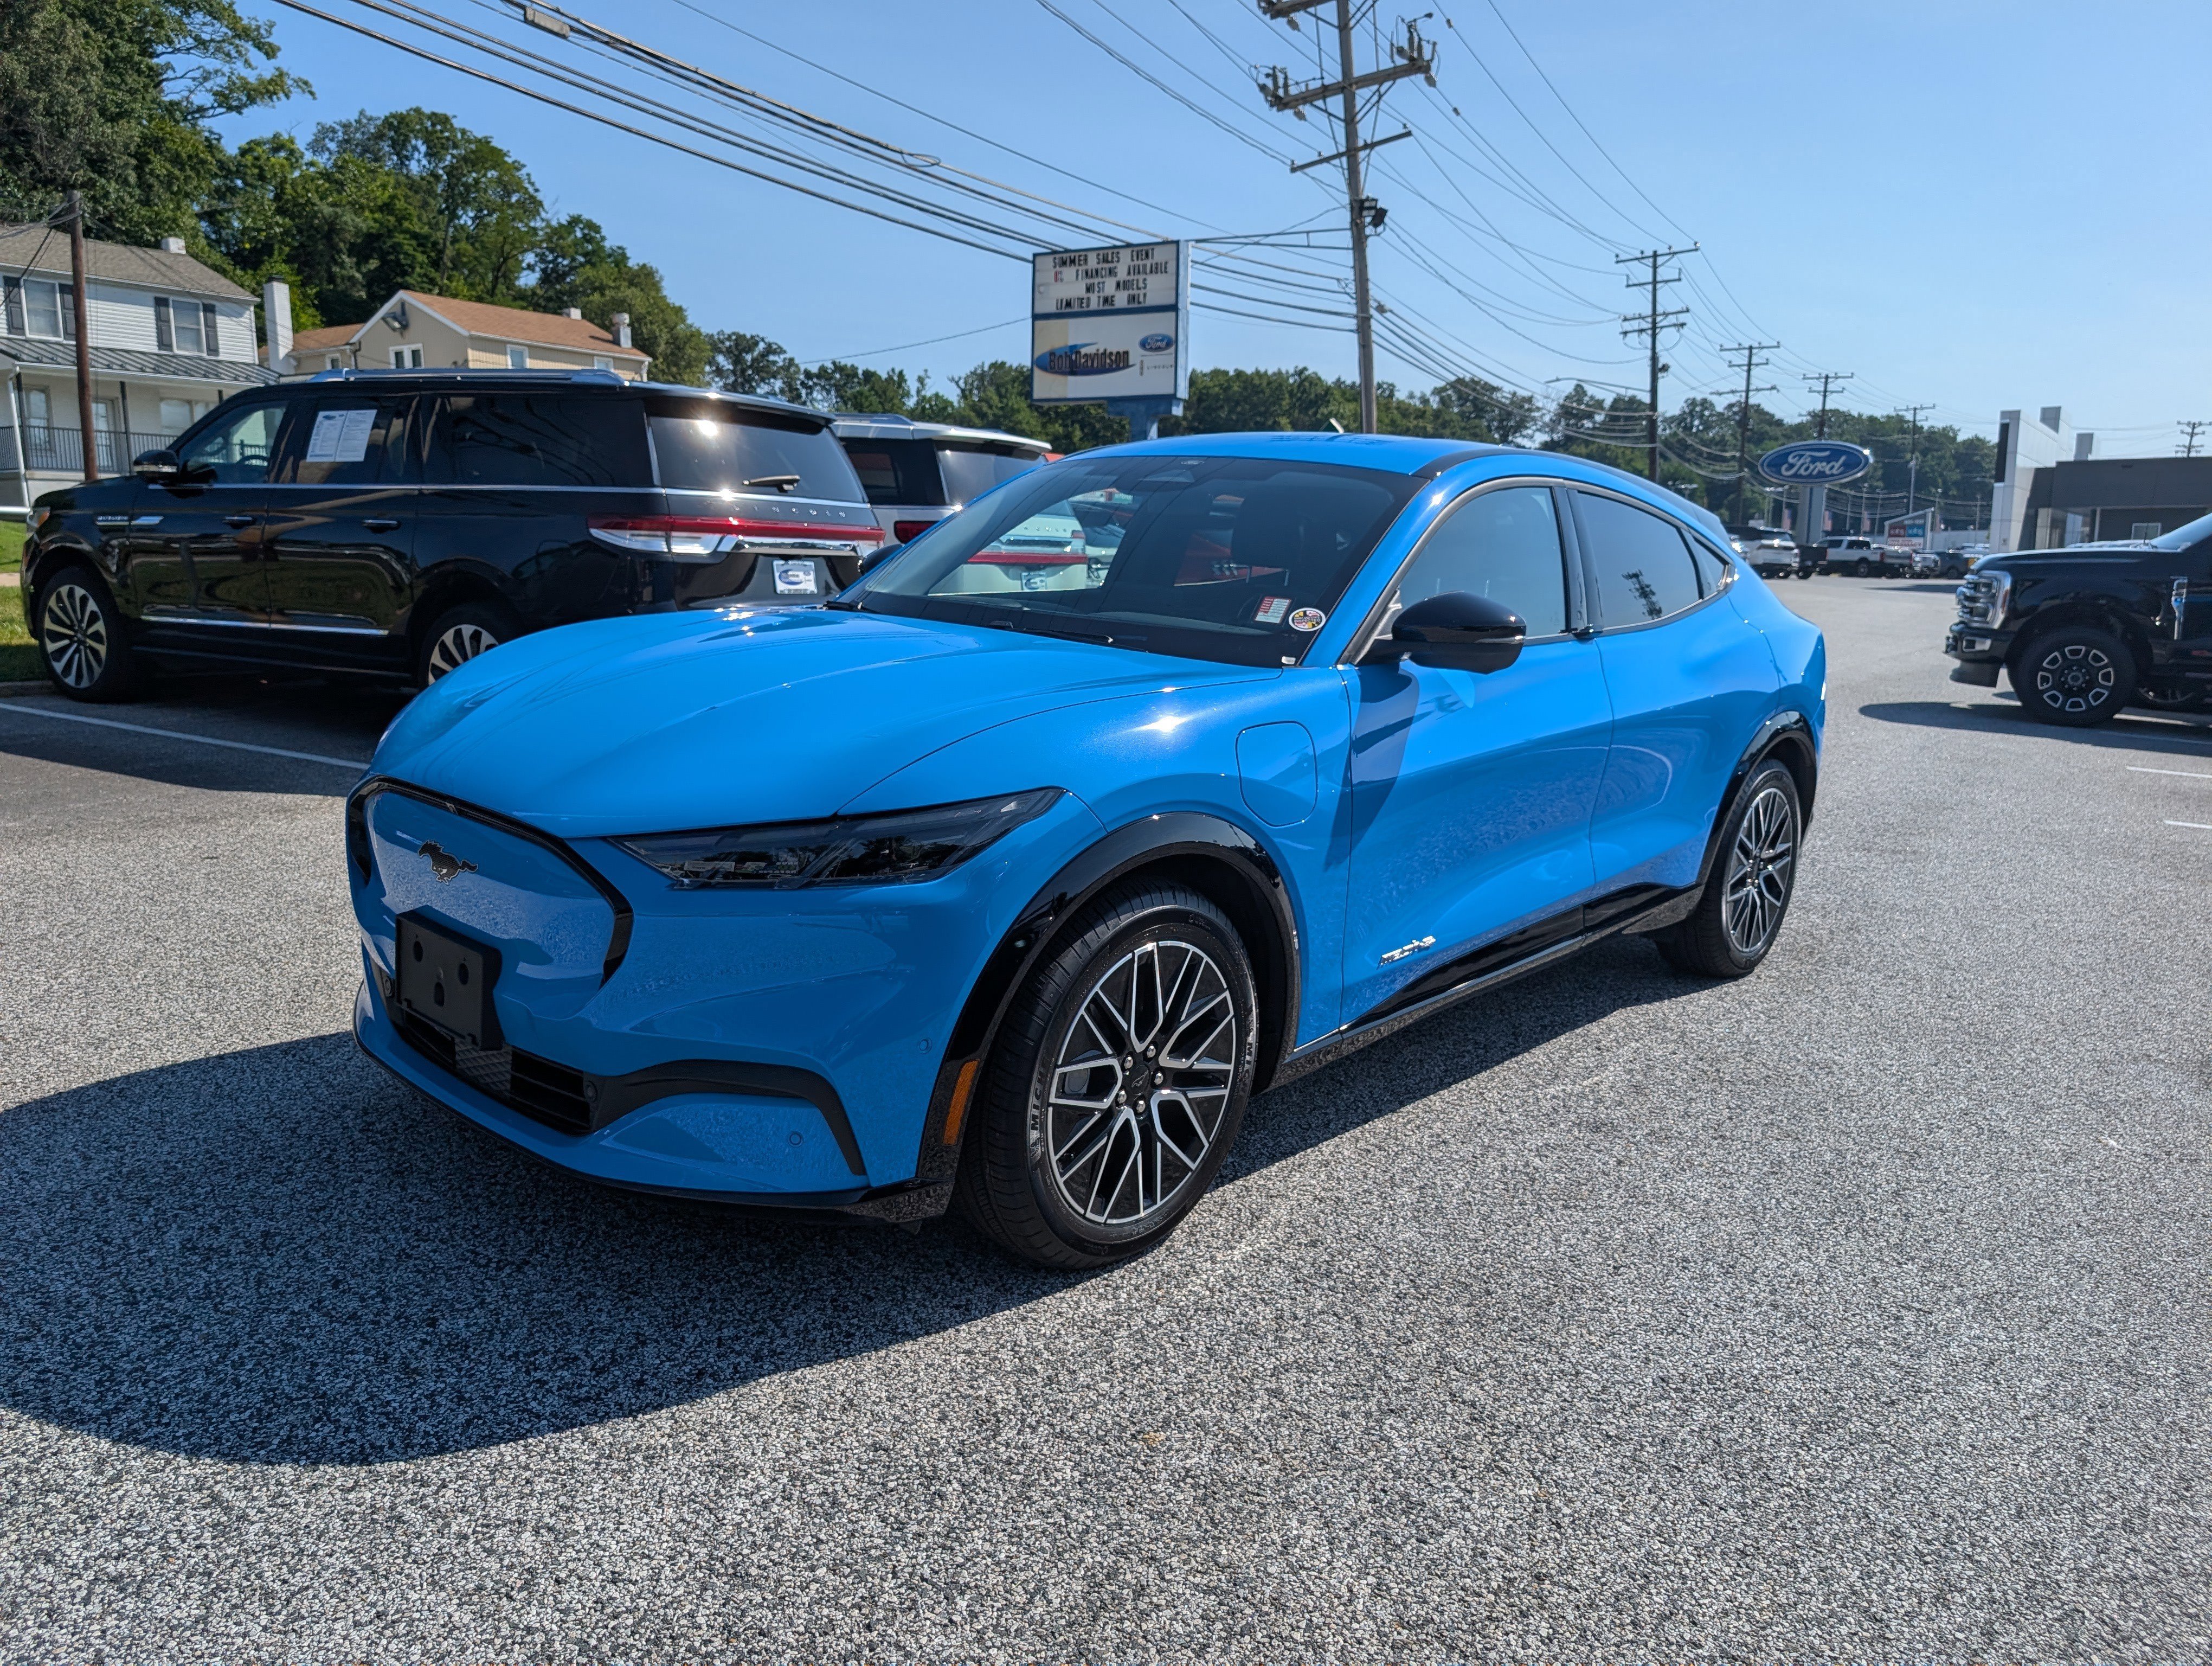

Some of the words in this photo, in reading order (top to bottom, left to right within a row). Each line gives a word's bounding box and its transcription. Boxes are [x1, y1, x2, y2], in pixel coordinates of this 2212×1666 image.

[1052, 254, 1088, 268] SUMMER
[1096, 251, 1120, 265] SALES
[1130, 248, 1155, 261] EVENT
[1076, 266, 1118, 281] FINANCING
[1127, 261, 1168, 276] AVAILABLE
[1085, 281, 1105, 293] MOST
[1115, 278, 1147, 291] MODELS
[1055, 297, 1091, 310] LIMITED
[1127, 292, 1147, 305] ONLY
[1145, 336, 1167, 349] Ford
[1049, 350, 1072, 370] Bob
[1073, 348, 1129, 368] Davidson
[1780, 450, 1847, 476] Ford
